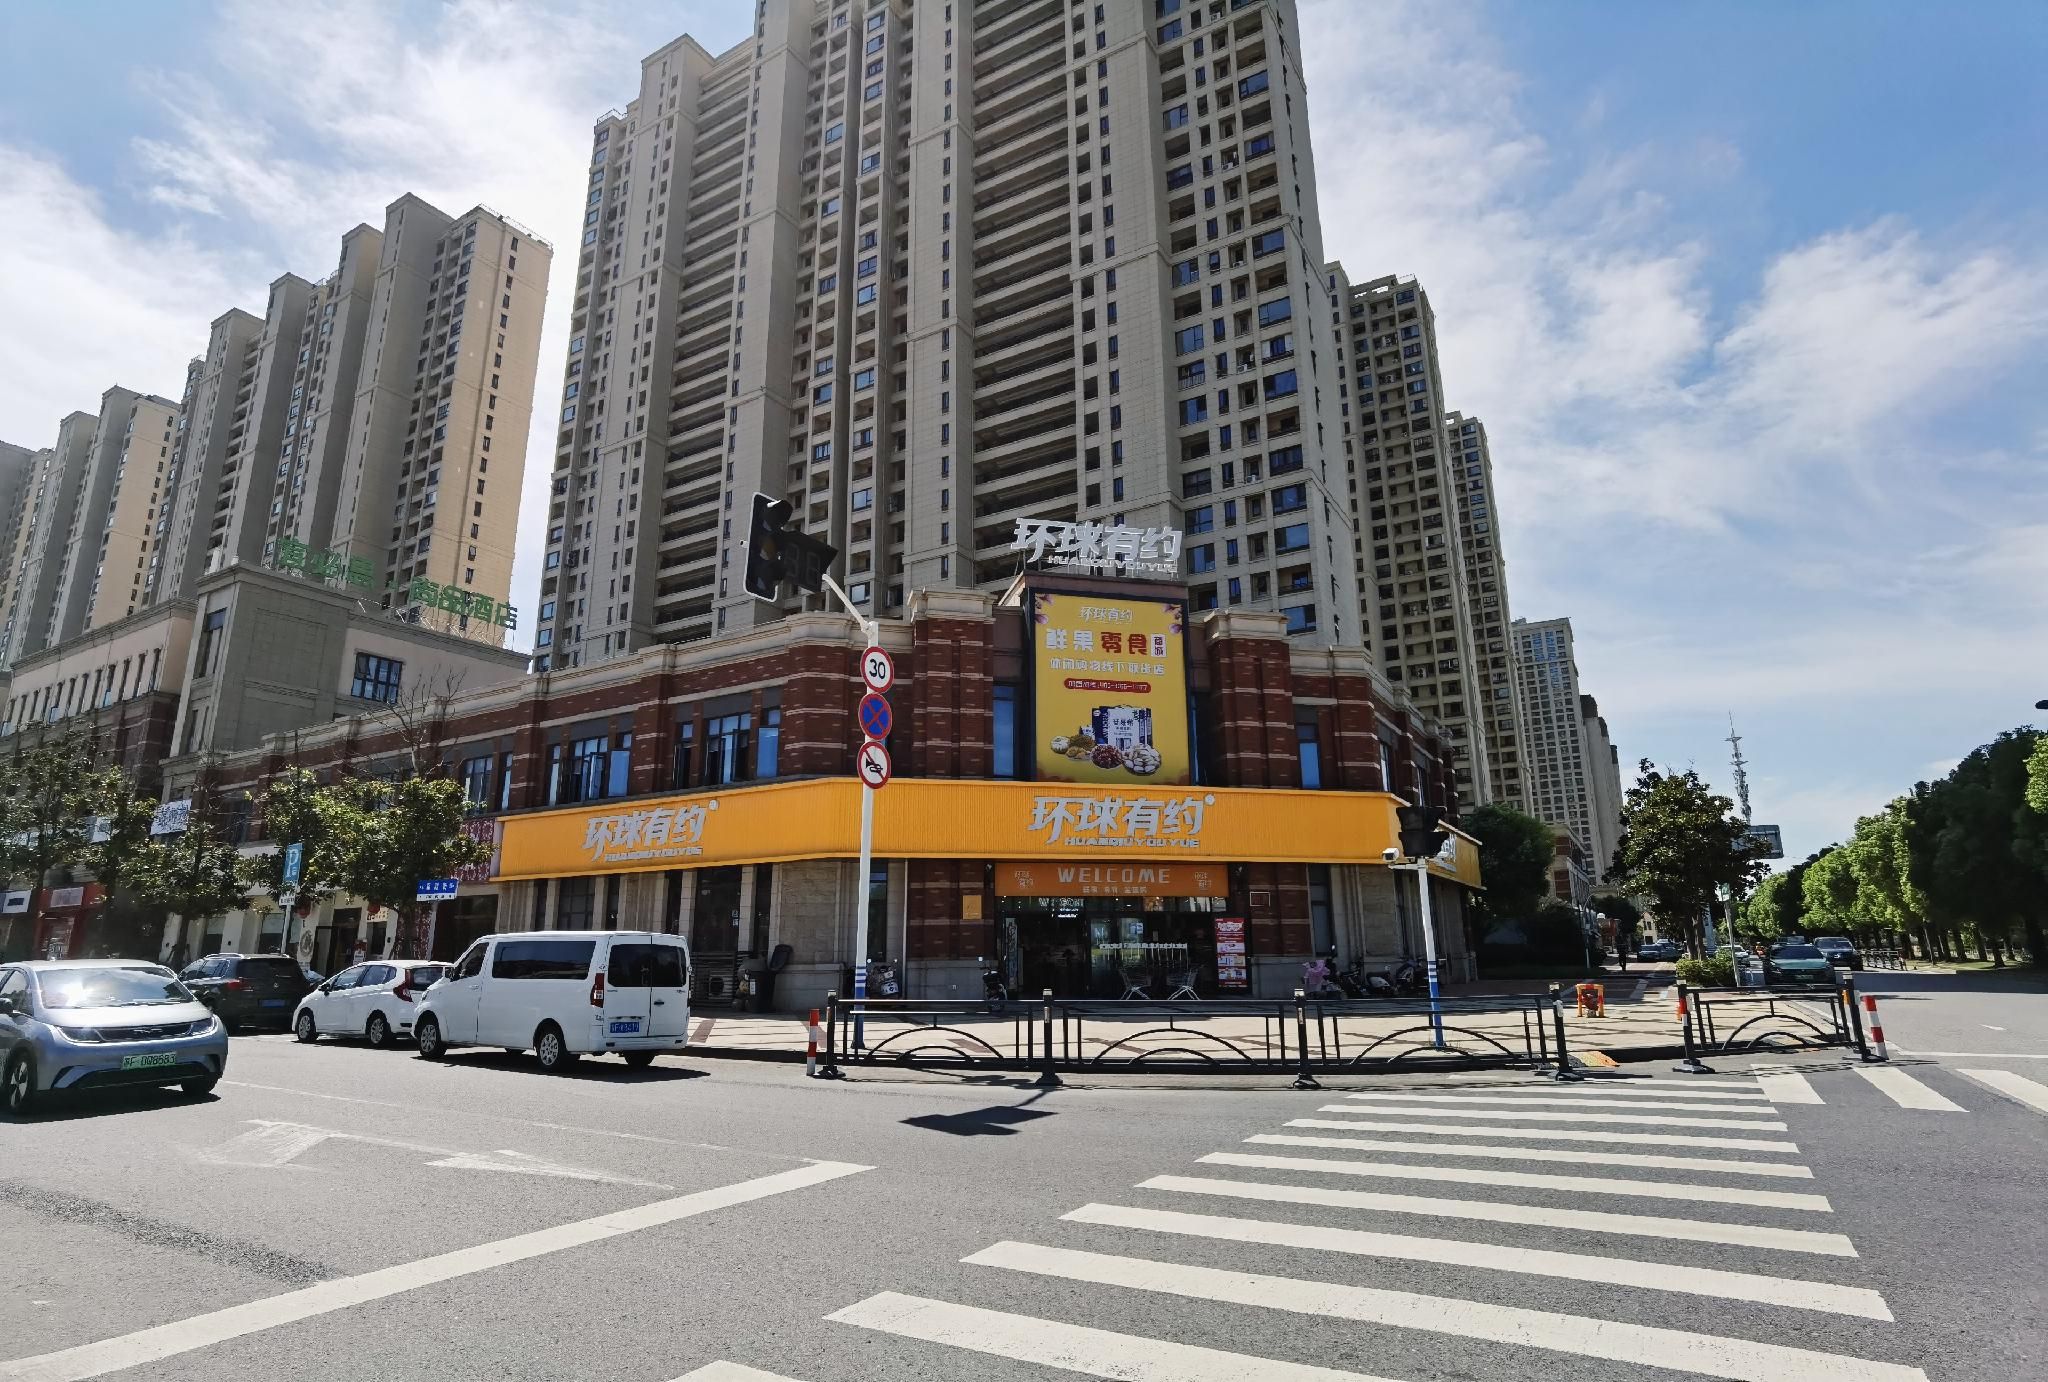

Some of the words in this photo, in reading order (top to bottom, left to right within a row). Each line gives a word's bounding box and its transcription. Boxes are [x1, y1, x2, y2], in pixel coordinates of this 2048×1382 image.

[1010, 517, 1183, 563] 环球有约
[869, 658, 886, 679] 30
[582, 804, 708, 862] 环球有约
[1027, 796, 1205, 845] 环球有约
[286, 848, 299, 878] P
[1057, 868, 1171, 884] WELCOME
